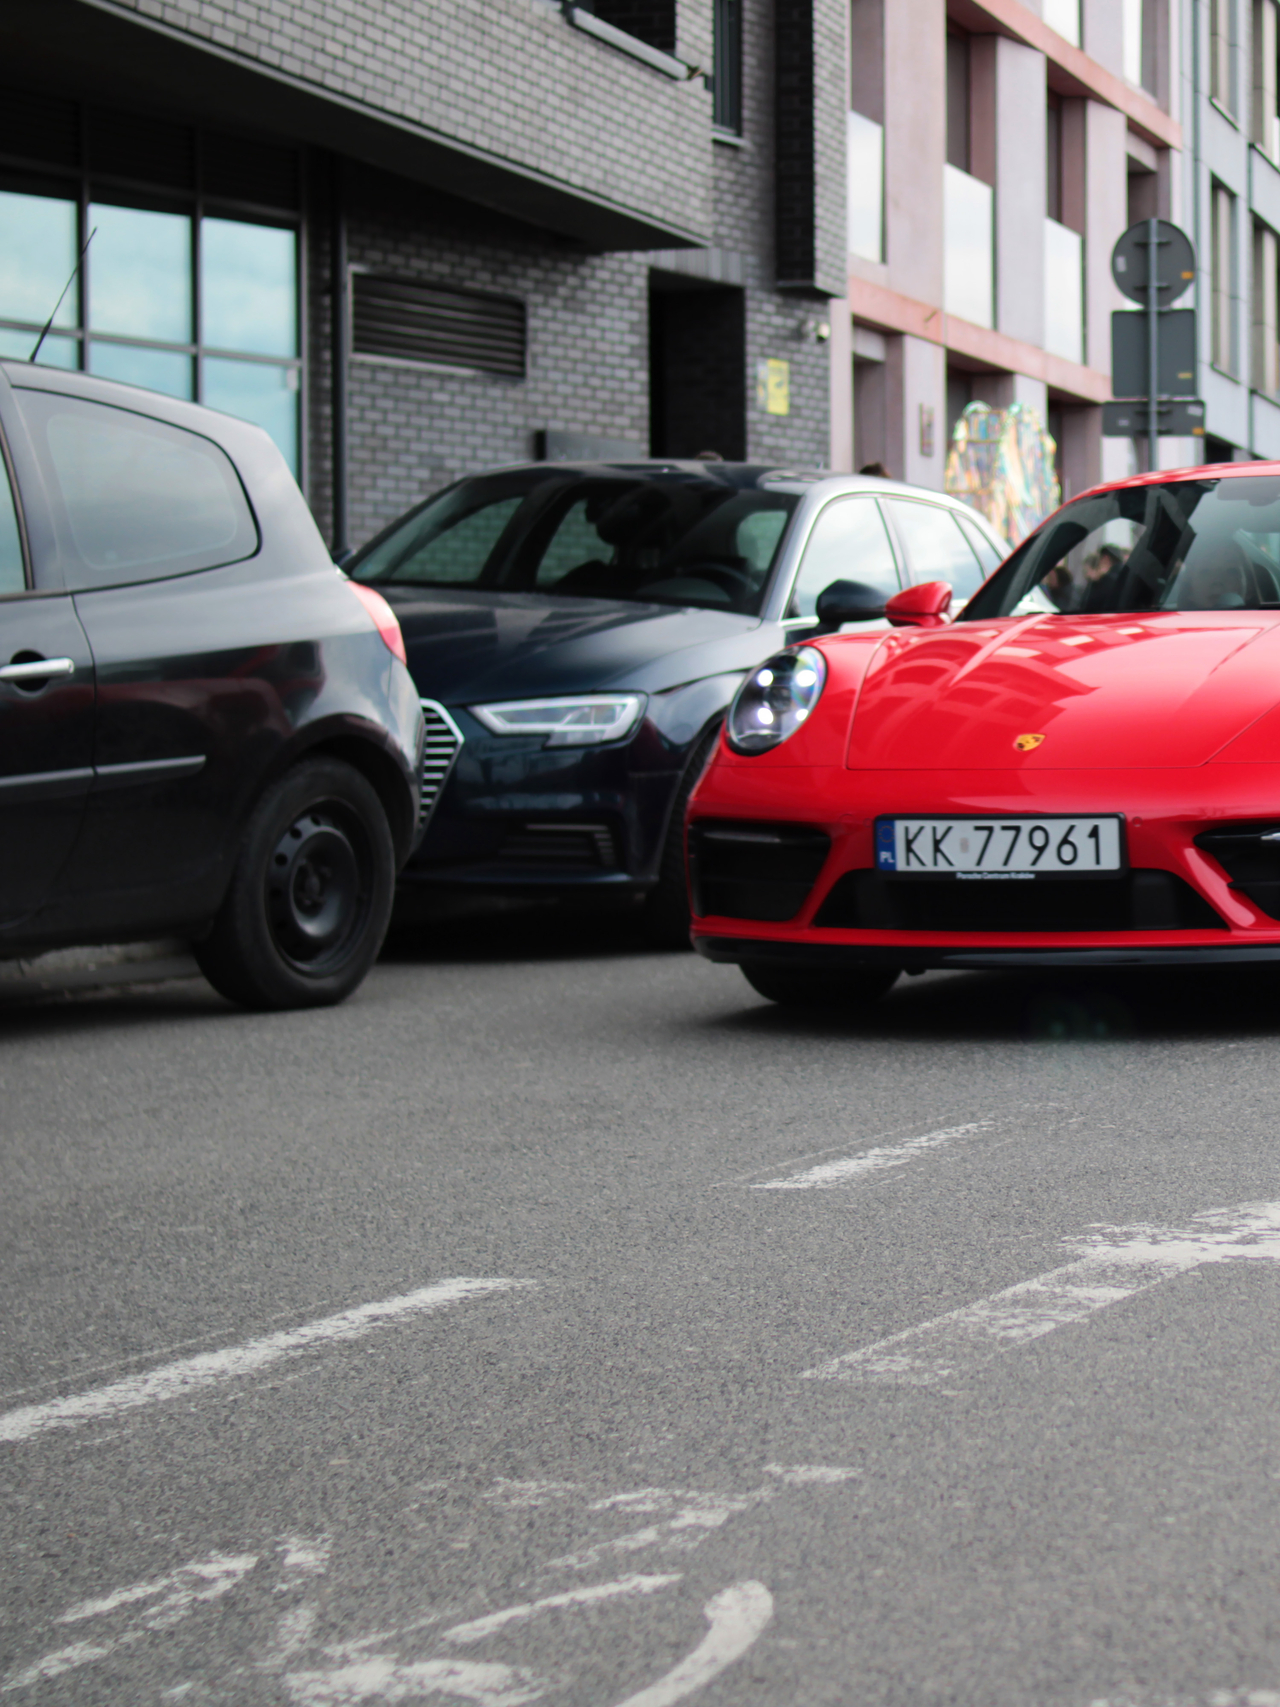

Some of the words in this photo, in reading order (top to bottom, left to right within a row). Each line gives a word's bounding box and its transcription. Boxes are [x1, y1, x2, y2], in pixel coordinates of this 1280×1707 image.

[879, 851, 896, 863] PL
[904, 825, 955, 867] KK
[973, 824, 1101, 867] 77961
